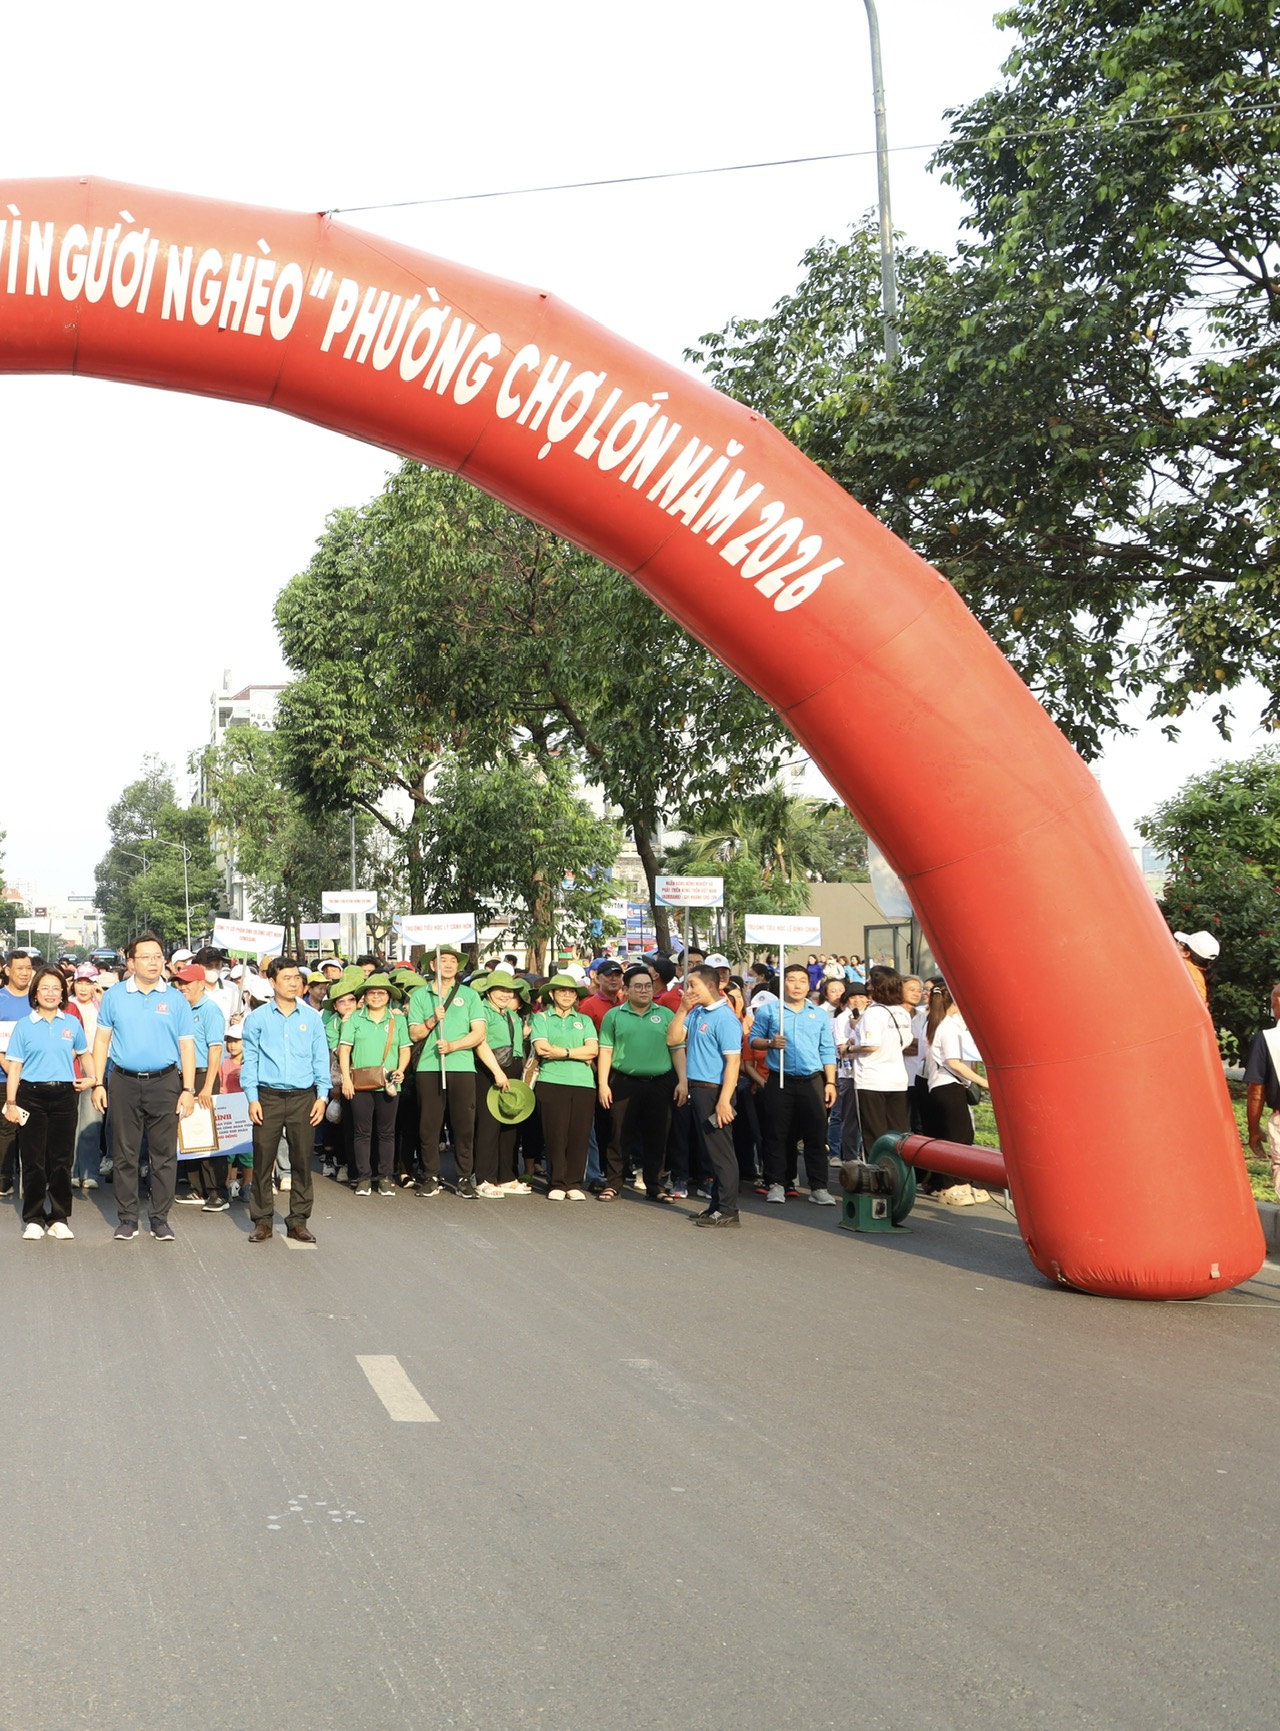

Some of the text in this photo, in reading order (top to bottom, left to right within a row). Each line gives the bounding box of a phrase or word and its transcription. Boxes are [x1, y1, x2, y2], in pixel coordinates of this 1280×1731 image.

[321, 278, 501, 405] PHƯỜNG
[497, 344, 607, 460] CHỢ
[574, 392, 682, 490] LỚN
[646, 436, 764, 545] NĂM
[719, 501, 844, 612] 2026
